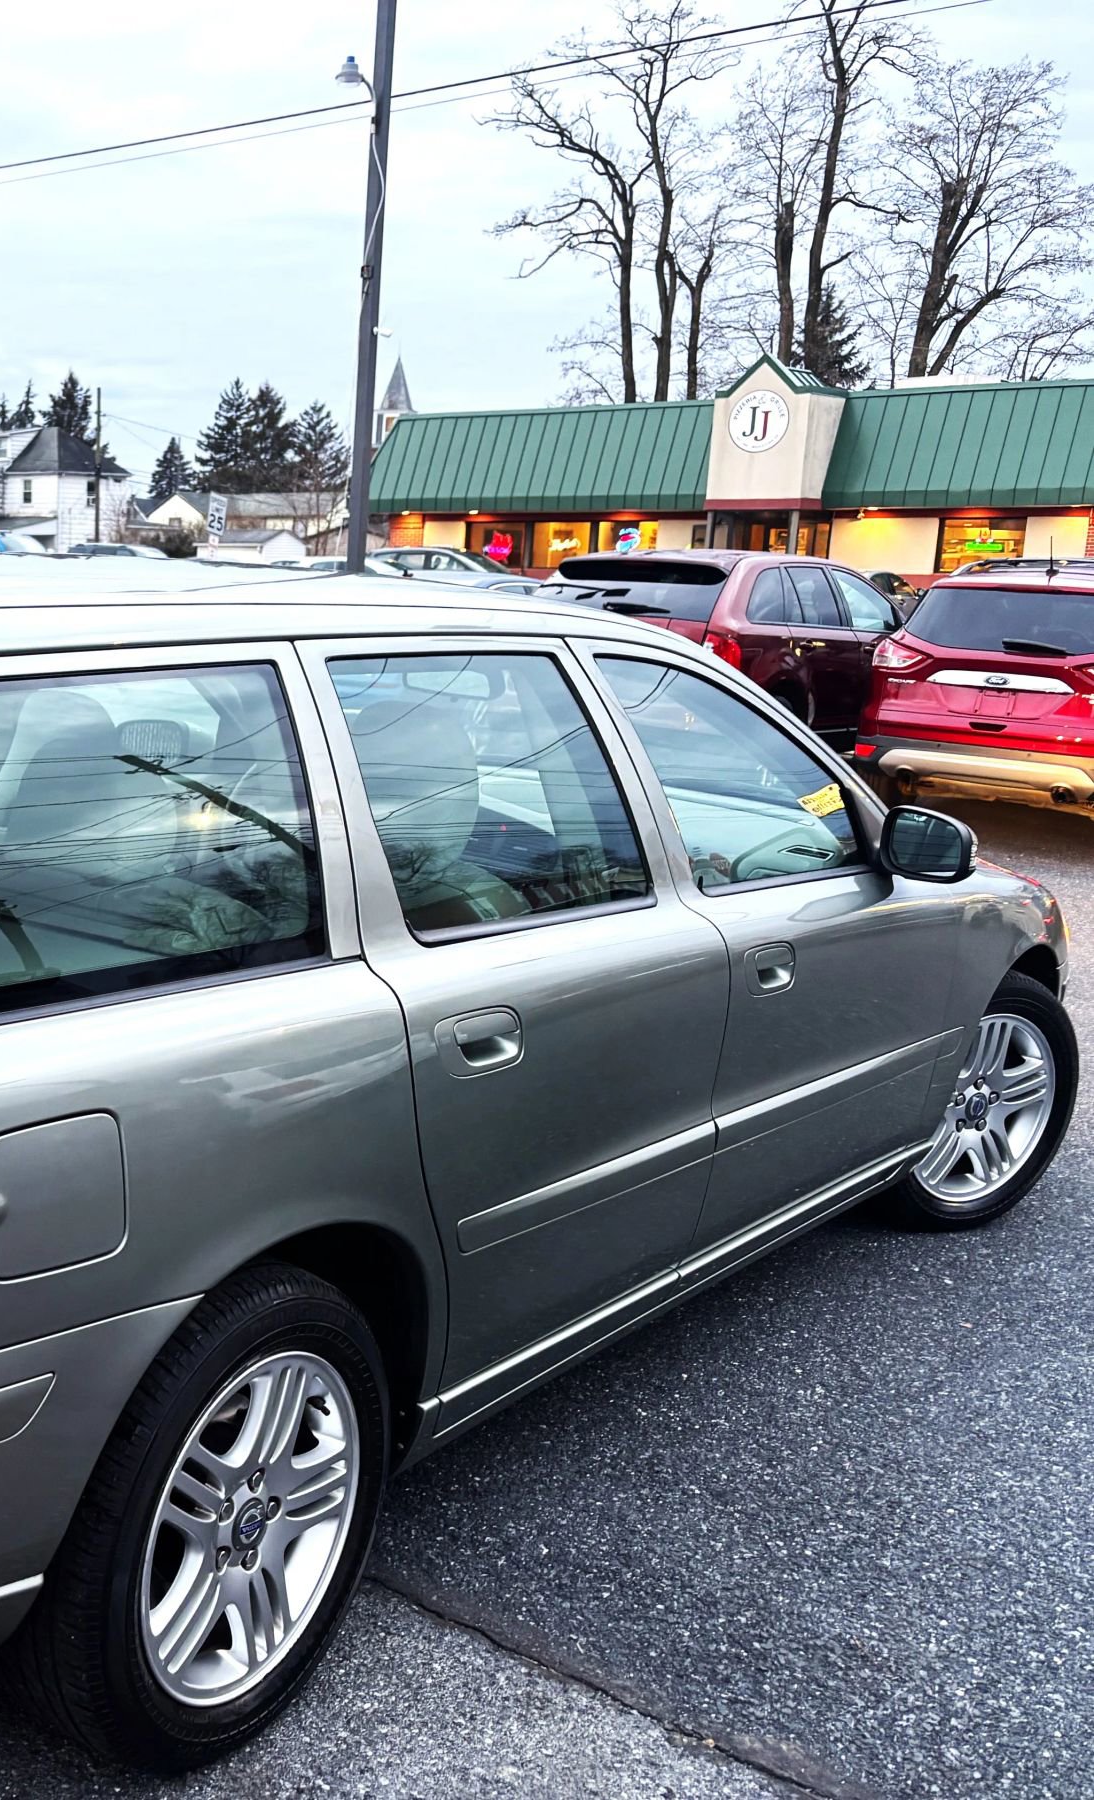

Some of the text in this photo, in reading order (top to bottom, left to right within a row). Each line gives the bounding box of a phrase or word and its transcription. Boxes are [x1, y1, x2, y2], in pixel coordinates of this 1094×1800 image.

[733, 395, 757, 420] PIZZERIA
[769, 396, 786, 418] GRILLE
[742, 406, 773, 442] JJ
[208, 513, 224, 532] 25
